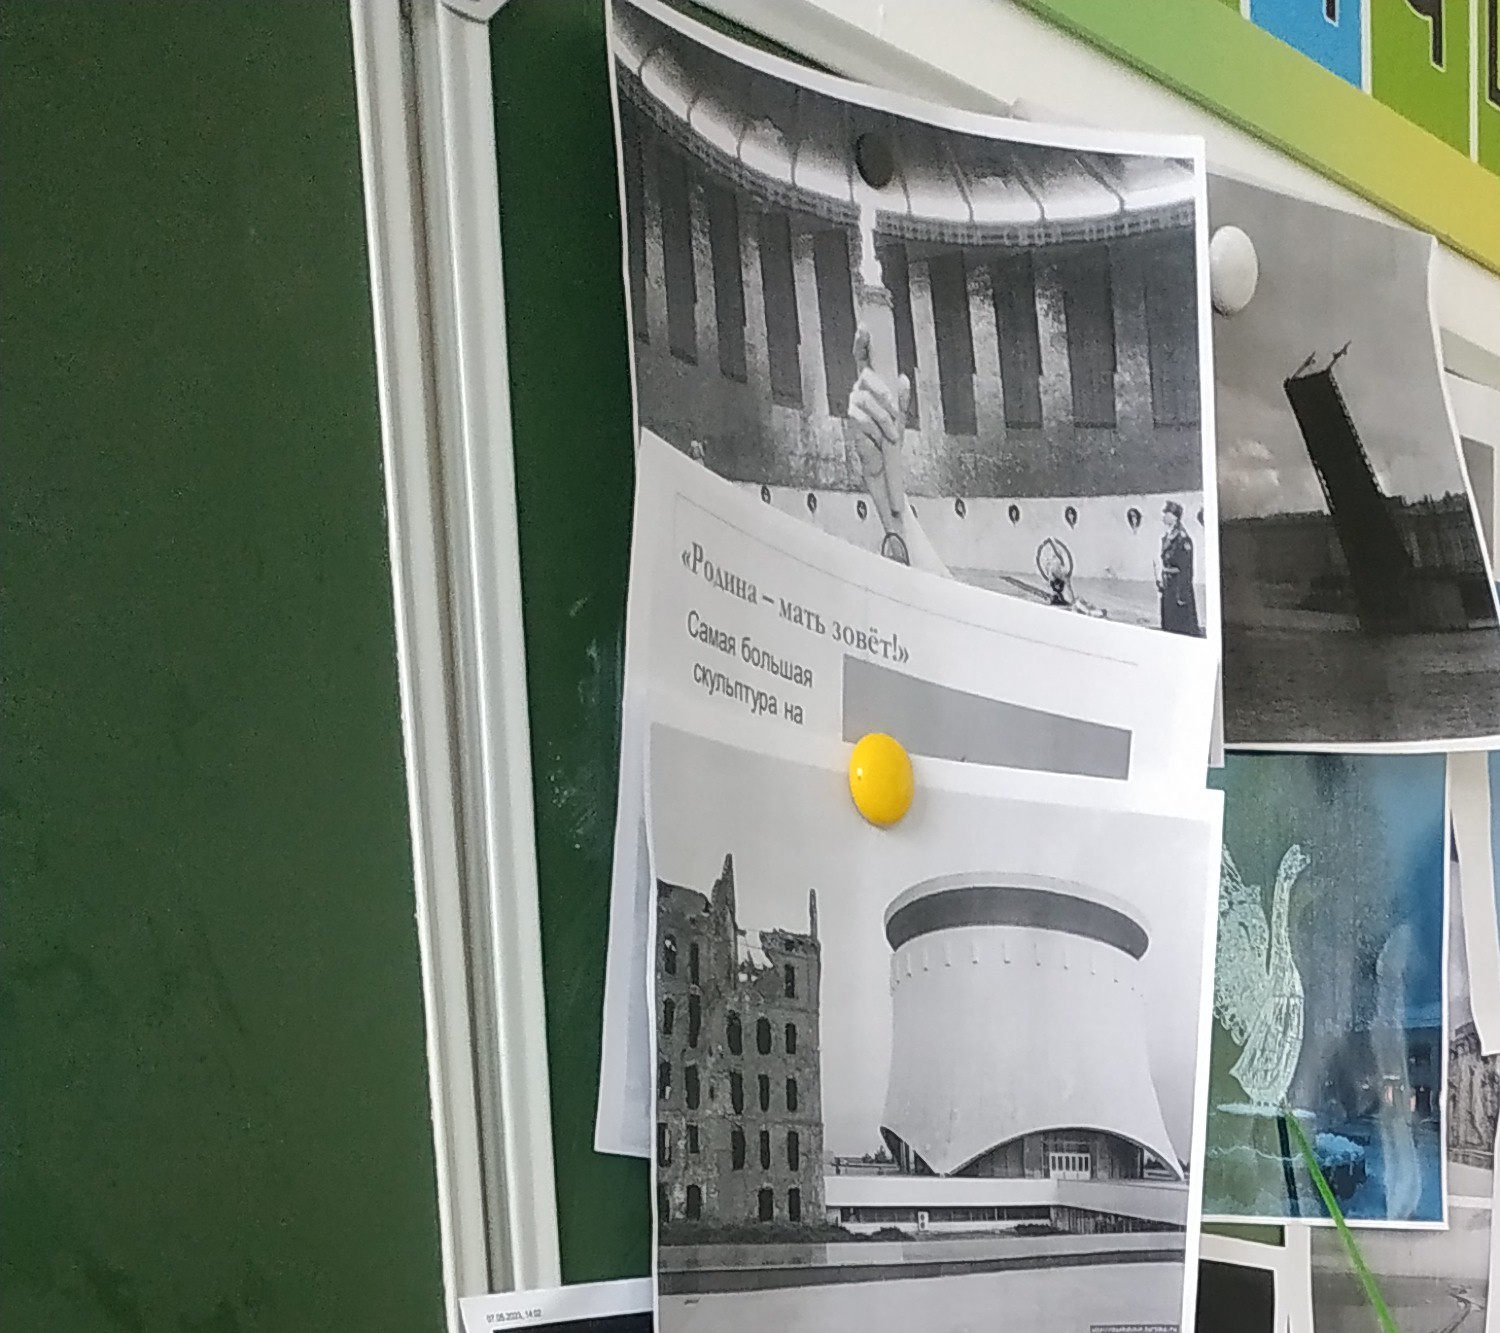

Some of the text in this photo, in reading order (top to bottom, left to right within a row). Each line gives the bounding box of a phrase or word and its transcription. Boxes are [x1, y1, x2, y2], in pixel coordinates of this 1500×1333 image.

[682, 542, 757, 604] «Родина
[779, 598, 826, 635] мать
[832, 621, 909, 664] зовёт!»
[687, 610, 813, 688] Самая большая
[693, 662, 804, 725] скульптура на
